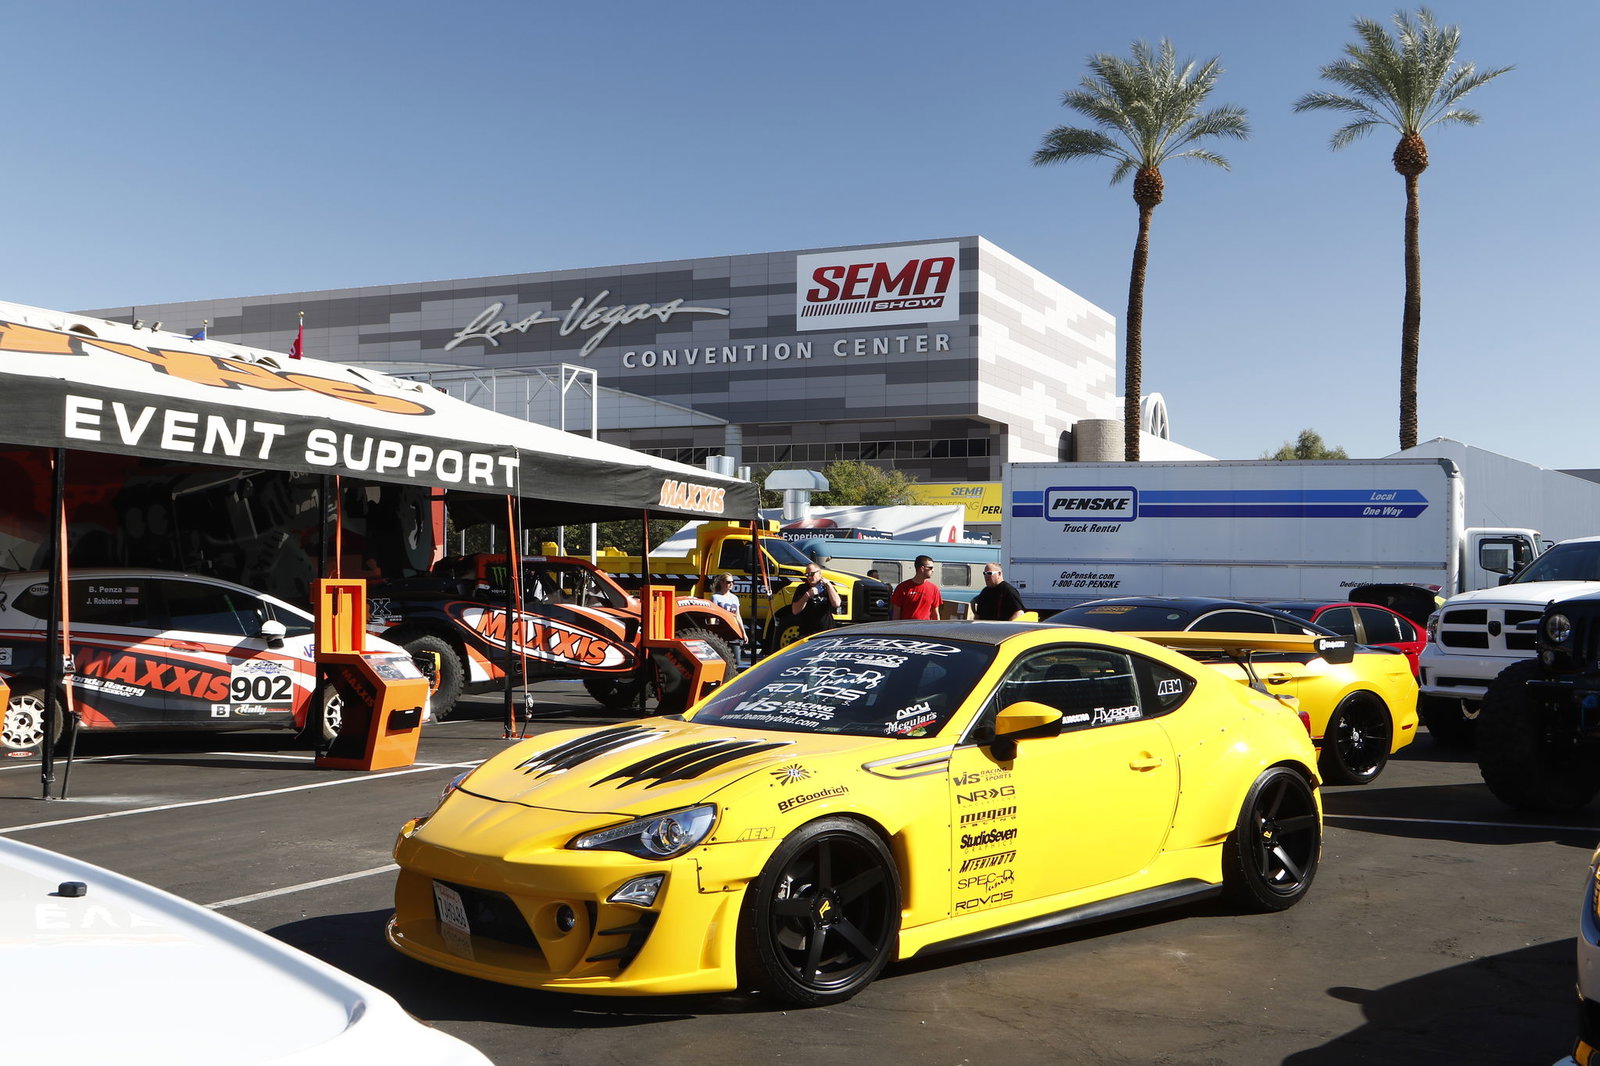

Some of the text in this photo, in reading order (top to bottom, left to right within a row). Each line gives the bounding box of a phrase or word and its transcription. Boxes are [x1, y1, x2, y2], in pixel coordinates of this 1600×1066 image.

[806, 256, 955, 302] SEMA
[874, 298, 941, 310] SHOW
[445, 290, 729, 357] Las Vegas
[622, 333, 950, 369] CONVENTION CENTER
[64, 394, 520, 488] EVENT SUPPORT
[659, 479, 726, 514] MAXXIS
[951, 486, 984, 496] SEMA
[1370, 491, 1397, 501] Local
[1051, 498, 1130, 510] PENSKE
[1362, 506, 1403, 518] One Way
[1063, 523, 1121, 533] Truck Rental
[782, 531, 835, 542] Experience
[1060, 571, 1115, 580] GoPenske.com
[1052, 579, 1121, 589] 1-800-GO-PENSKE
[93, 597, 123, 605] Robinson
[476, 610, 609, 666] MAXXIS
[73, 646, 231, 703] MAXXIS
[103, 680, 146, 697] Racing
[231, 675, 293, 702] 902
[757, 683, 867, 701] ROVOS
[1157, 679, 1183, 695] AEM
[216, 705, 227, 716] B
[239, 703, 268, 716] Rally
[781, 709, 834, 721] SPORTS
[720, 713, 820, 728] www.teamhybrid.com
[985, 773, 1012, 781] SPORTS
[778, 785, 849, 811] BFGoodrich
[960, 806, 1017, 824] megan
[736, 826, 775, 841] AEM
[960, 828, 1018, 849] StudioSeven
[959, 850, 1017, 873] MISHIMOTO
[955, 890, 1014, 911] ROVOS
